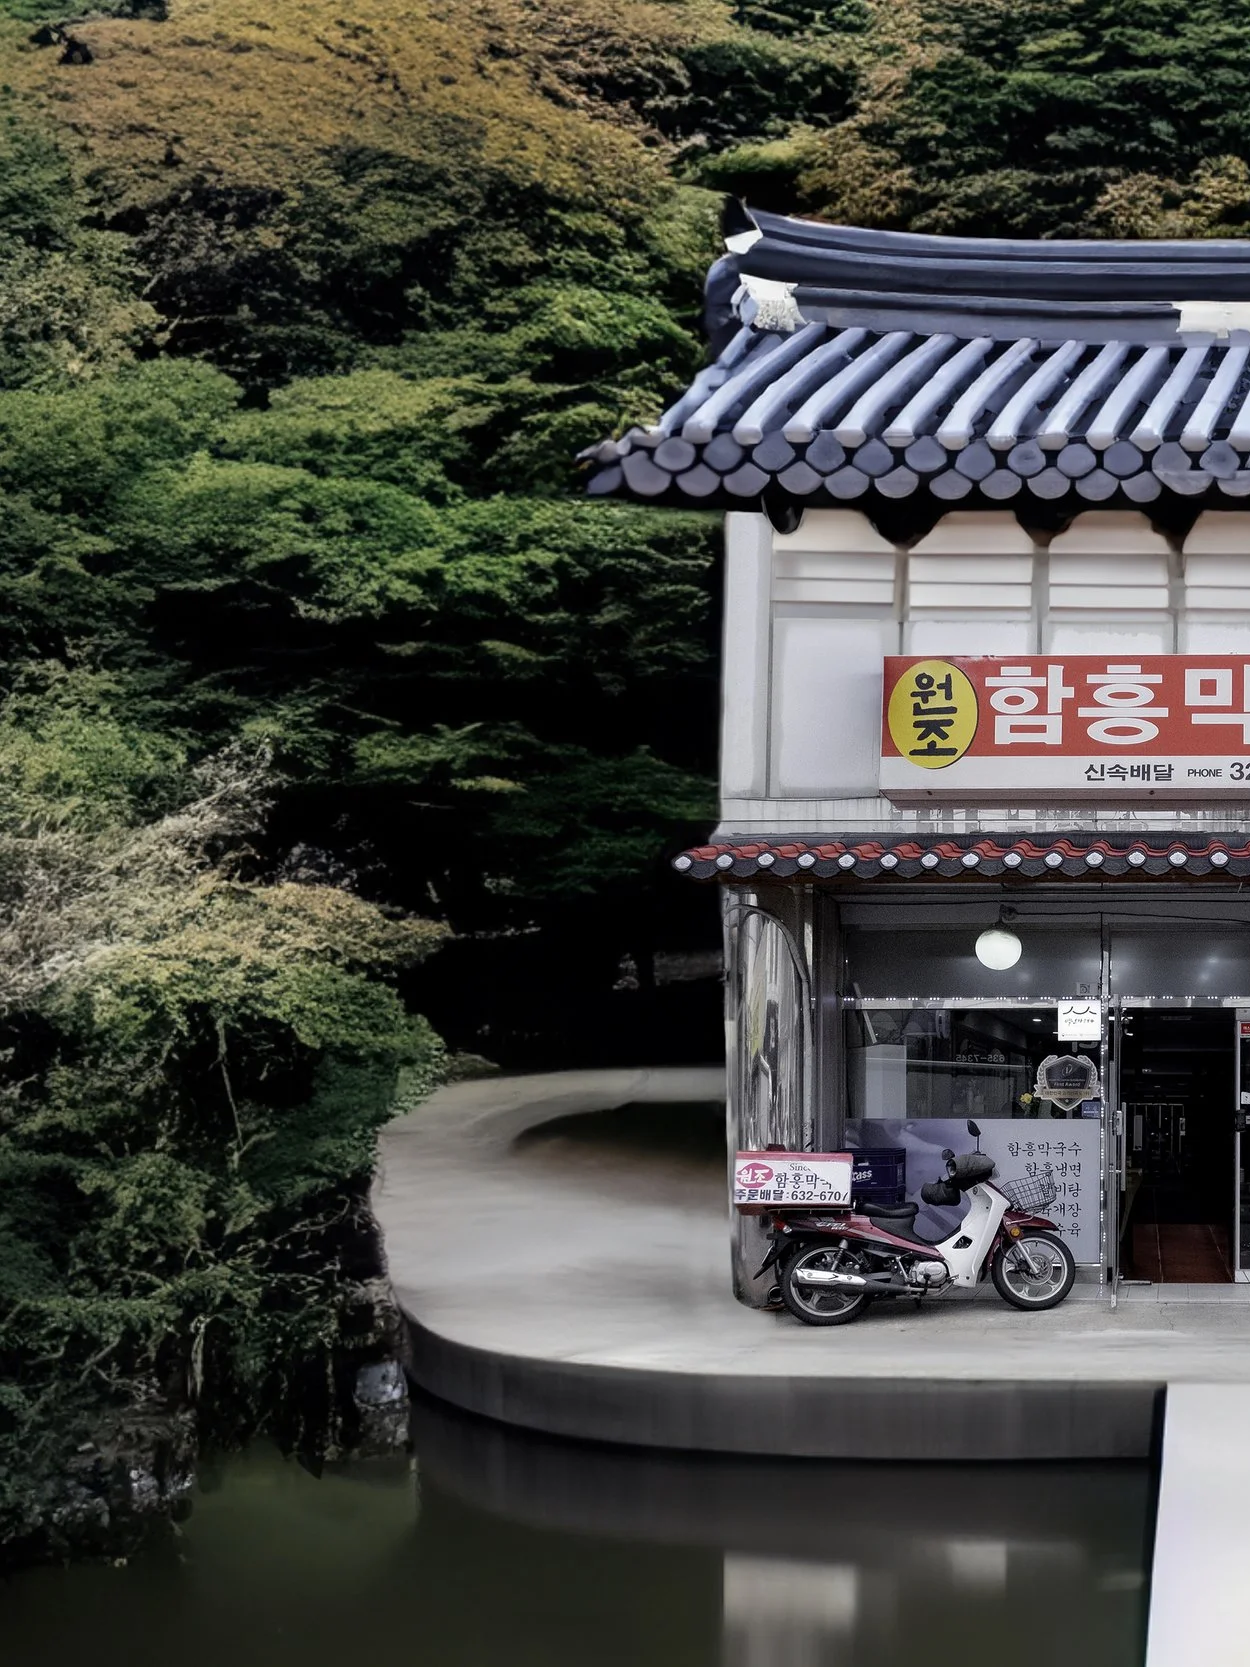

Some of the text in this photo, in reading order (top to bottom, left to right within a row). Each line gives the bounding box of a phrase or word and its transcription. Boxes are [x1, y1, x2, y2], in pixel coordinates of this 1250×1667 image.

[909, 672, 958, 757] 원조
[1084, 763, 1175, 782] 신속배달
[1187, 768, 1223, 778] PHONE
[1007, 1141, 1082, 1157] 함흥막국수
[736, 1168, 770, 1183] 원조
